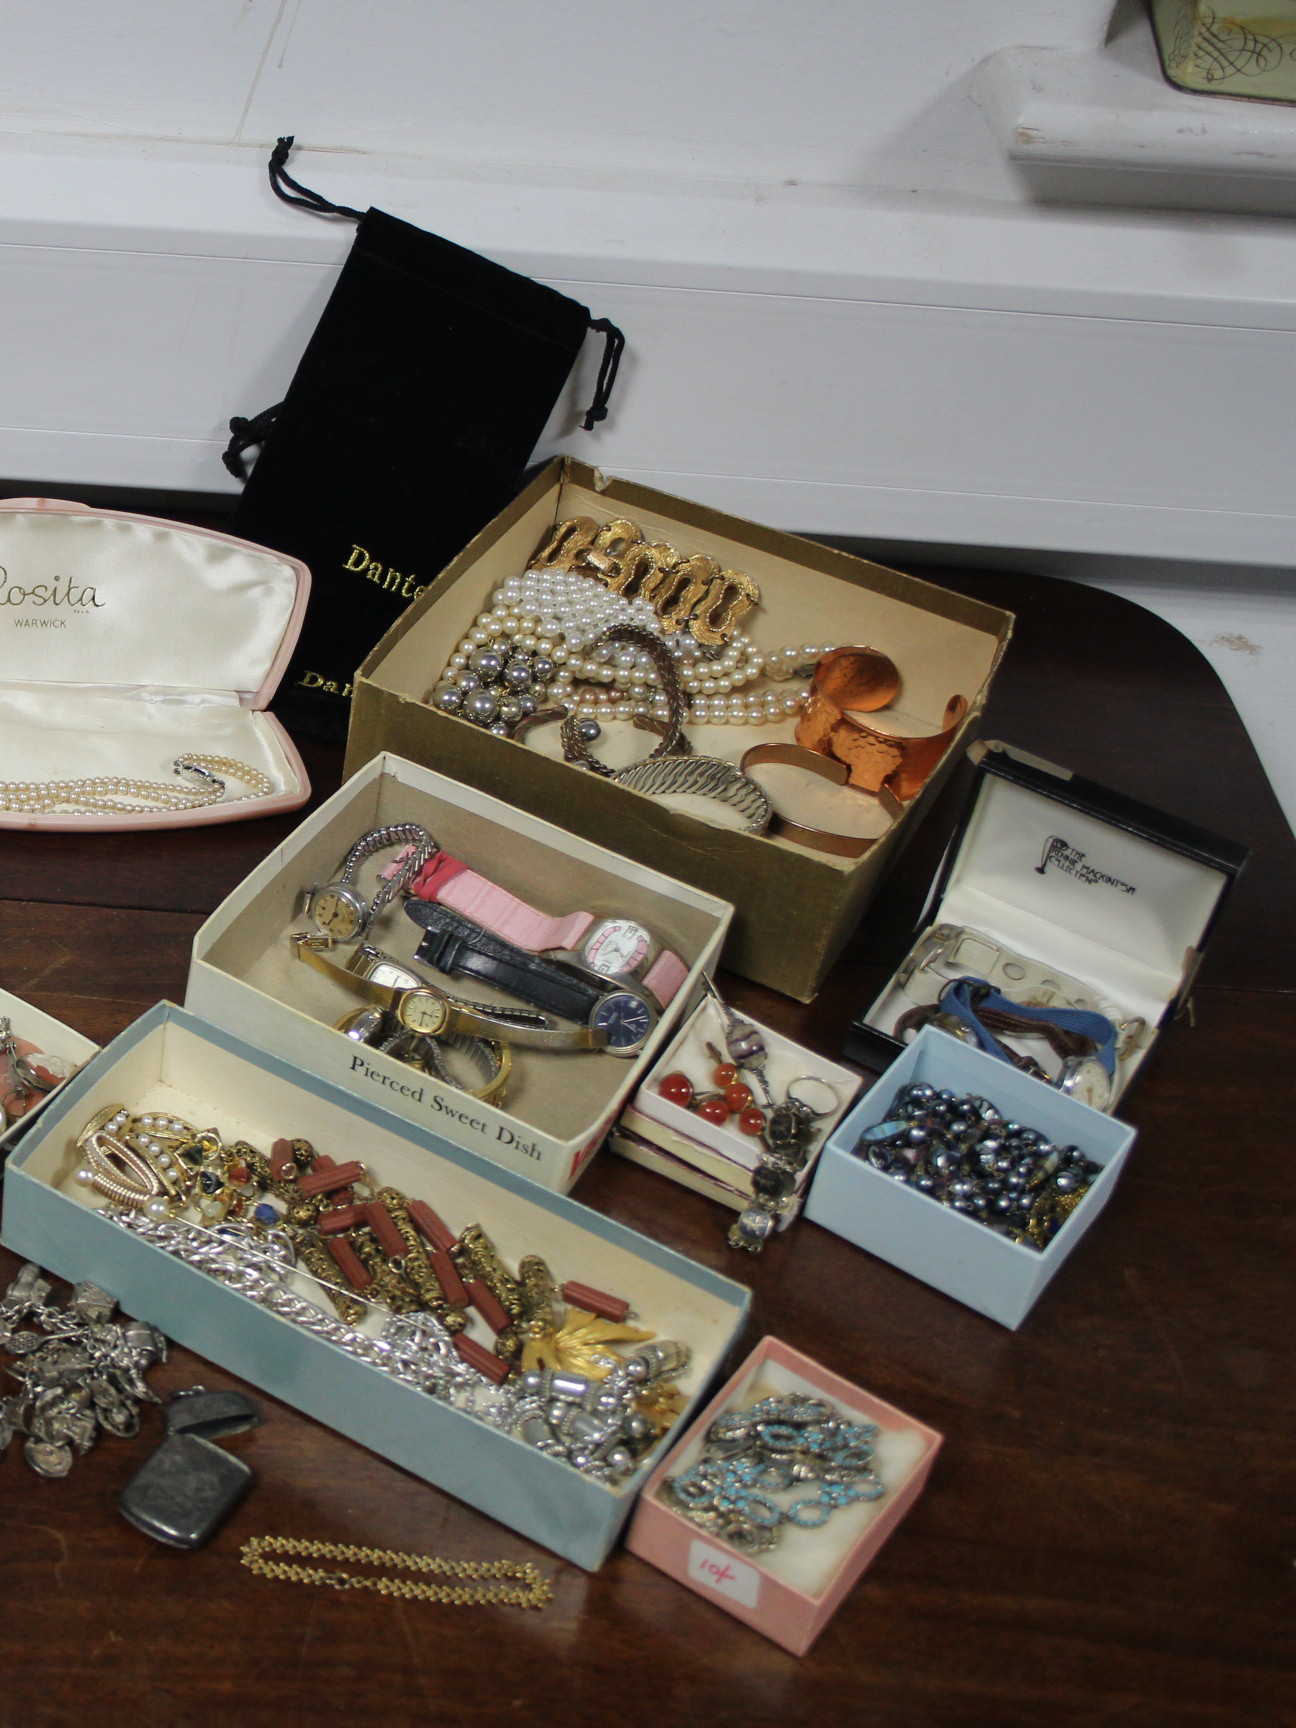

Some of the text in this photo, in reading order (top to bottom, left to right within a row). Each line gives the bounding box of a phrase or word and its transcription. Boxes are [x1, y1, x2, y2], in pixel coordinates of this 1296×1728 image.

[13, 618, 67, 629] WARWICK
[348, 1054, 543, 1162] Pierced Sweet Dish
